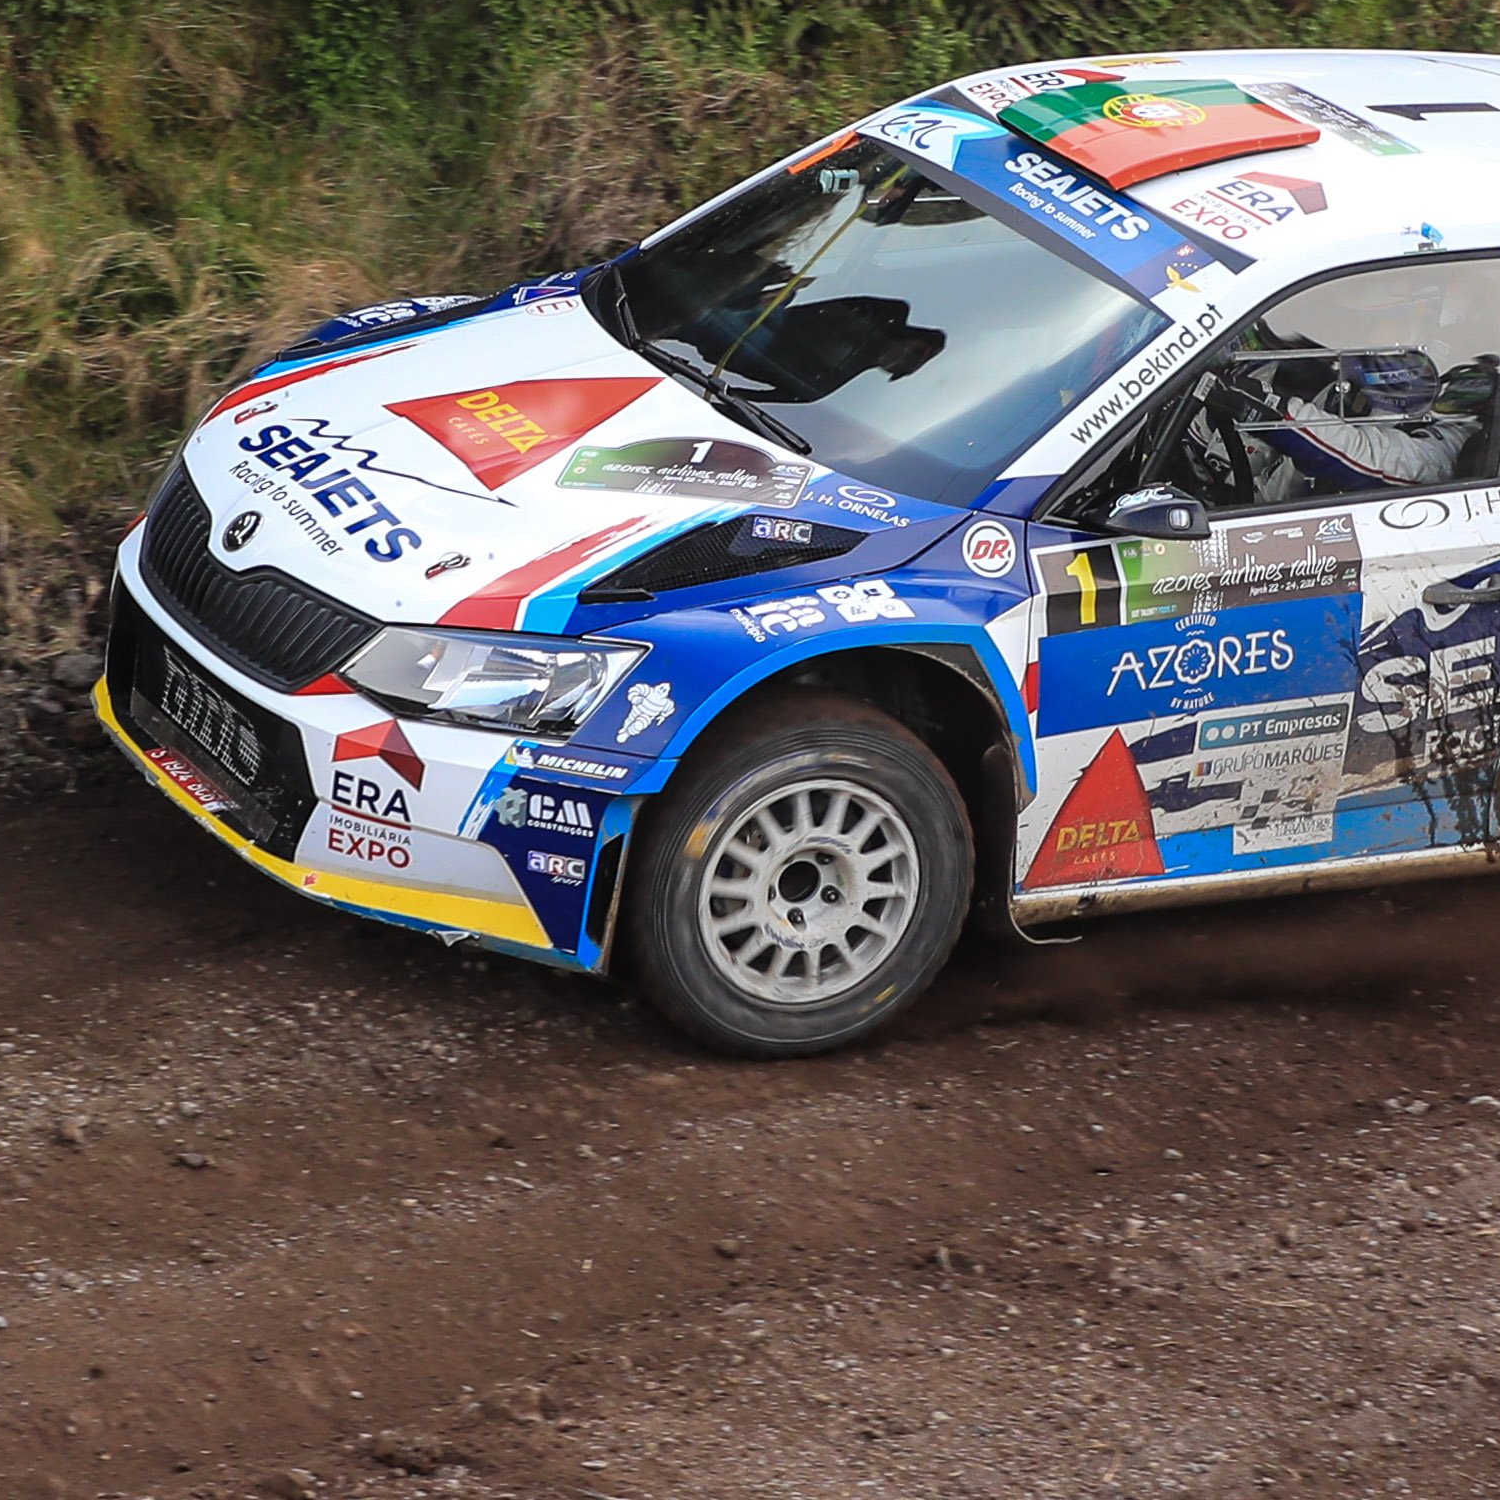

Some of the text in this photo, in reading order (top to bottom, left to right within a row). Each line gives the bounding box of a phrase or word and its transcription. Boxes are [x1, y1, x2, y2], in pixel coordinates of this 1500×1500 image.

[1021, 71, 1067, 90] ER
[1004, 152, 1150, 241] SEAJETS
[1008, 182, 1097, 240] Racing to summer
[1217, 180, 1294, 221] ERA
[1170, 199, 1247, 240] EXPO
[1070, 303, 1223, 444] www.bekind.pt
[455, 390, 549, 454] DELTA
[690, 441, 714, 464] 1
[229, 460, 344, 557] Racing to summer
[238, 425, 422, 563] SEAJETS
[803, 491, 911, 528] J. H. ORNELAS
[1464, 494, 1480, 522] J.
[1066, 553, 1096, 624] 1
[1152, 571, 1213, 595] azores
[1220, 553, 1283, 585] airlines
[1290, 545, 1338, 583] rallye
[1175, 614, 1217, 631] CERTIFIED
[1106, 629, 1293, 696] AZORES
[1170, 691, 1215, 710] BY NATURE
[1239, 713, 1342, 738] PT Empresas
[537, 754, 628, 779] MICHELIN
[331, 770, 411, 823] ERA
[328, 828, 411, 869] EXPO
[329, 814, 412, 846] IMOBILIÁRIA
[527, 819, 594, 838] CONSTRUÇÕES
[1057, 820, 1140, 852] DELTA
